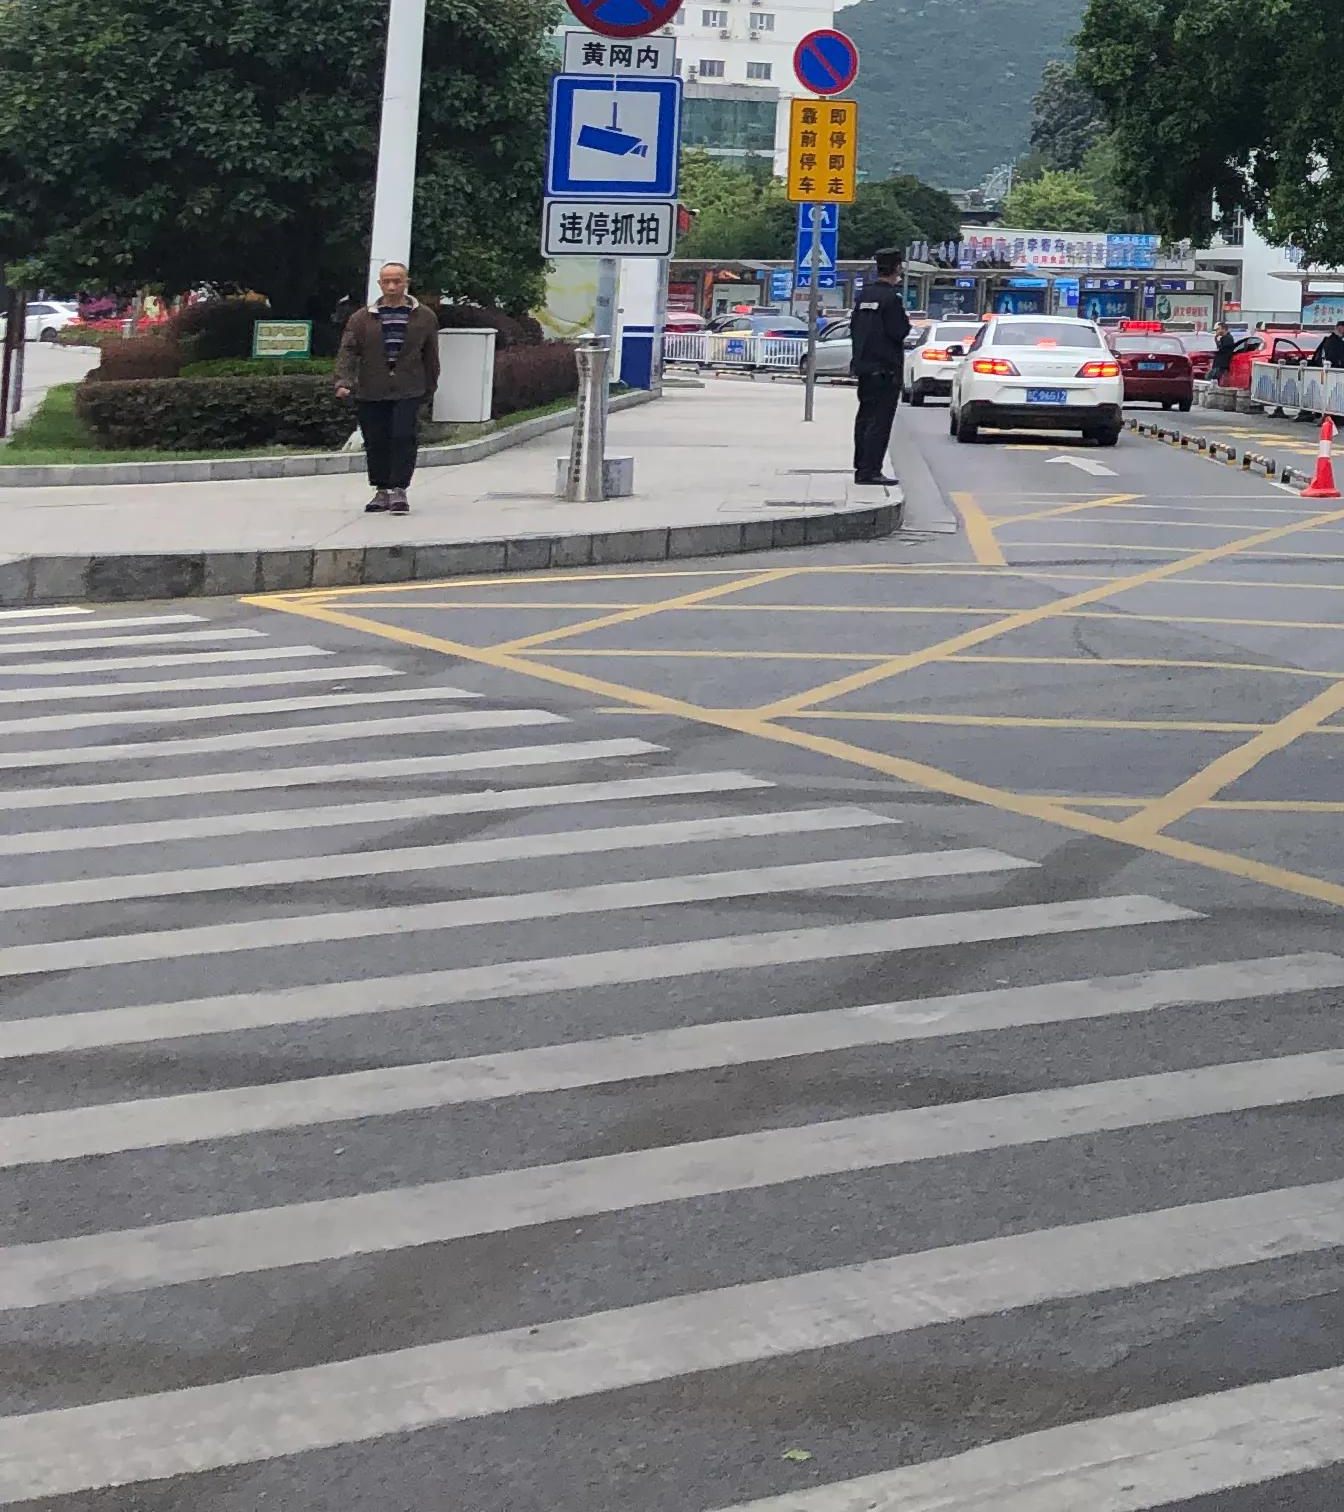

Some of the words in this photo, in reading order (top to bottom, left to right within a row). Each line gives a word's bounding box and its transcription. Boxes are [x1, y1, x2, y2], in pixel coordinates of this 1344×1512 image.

[582, 41, 659, 69] 黄网内
[798, 107, 818, 195] 靠前停车
[828, 108, 847, 195] 即停即走
[558, 212, 660, 246] 违停抓拍
